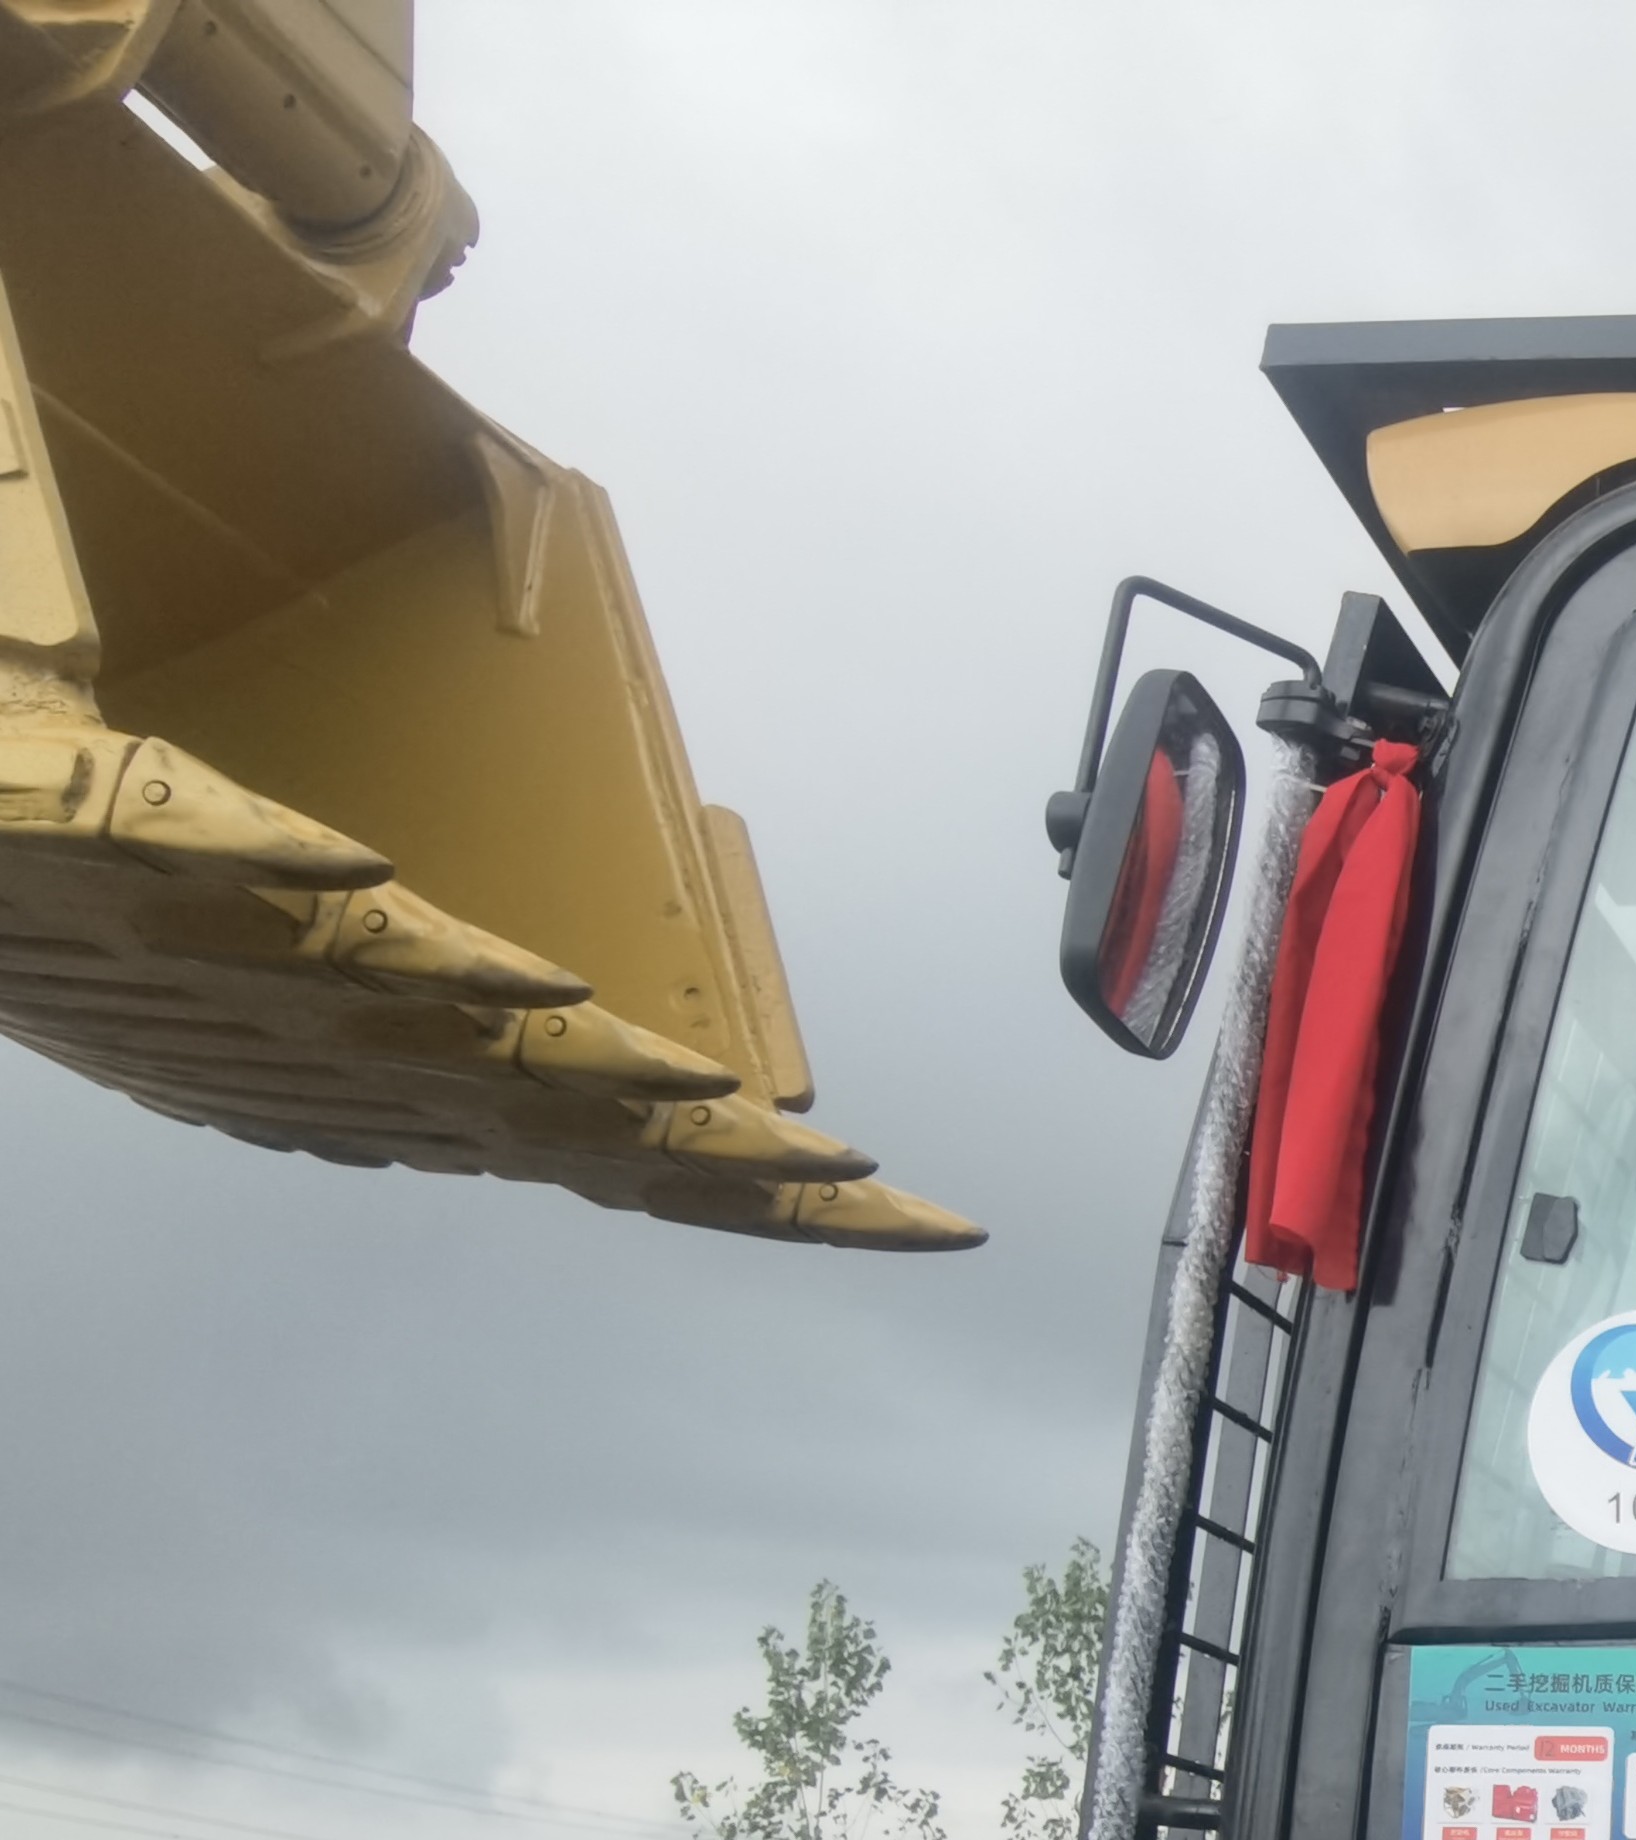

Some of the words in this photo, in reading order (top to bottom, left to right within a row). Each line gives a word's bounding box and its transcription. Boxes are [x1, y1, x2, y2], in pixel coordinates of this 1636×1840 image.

[1485, 1700, 1519, 1712] Used
[1528, 1701, 1595, 1713] Excavator
[1560, 1744, 1605, 1754] MONTHS
